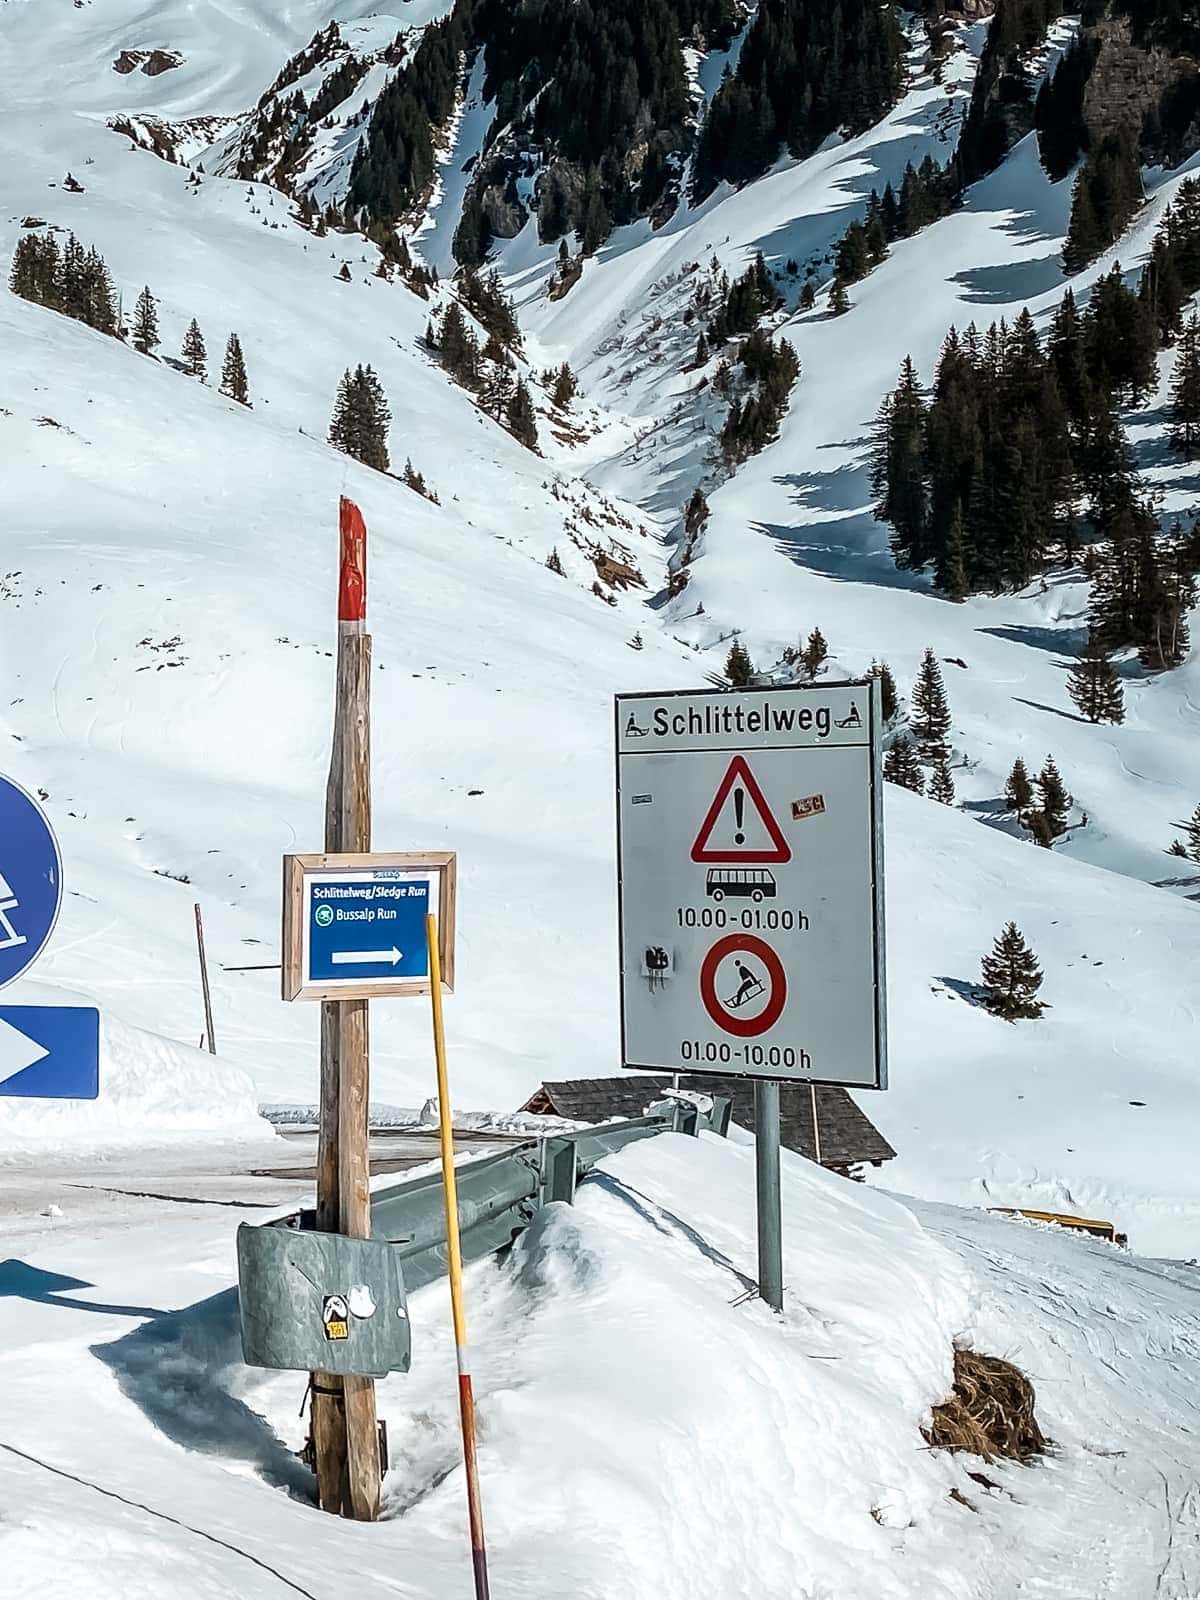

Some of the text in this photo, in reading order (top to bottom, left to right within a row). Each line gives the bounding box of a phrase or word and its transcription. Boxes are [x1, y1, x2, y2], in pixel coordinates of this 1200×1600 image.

[653, 702, 831, 738] Schlittelweg
[408, 886, 427, 897] Run
[336, 908, 397, 922] Bussalp Run
